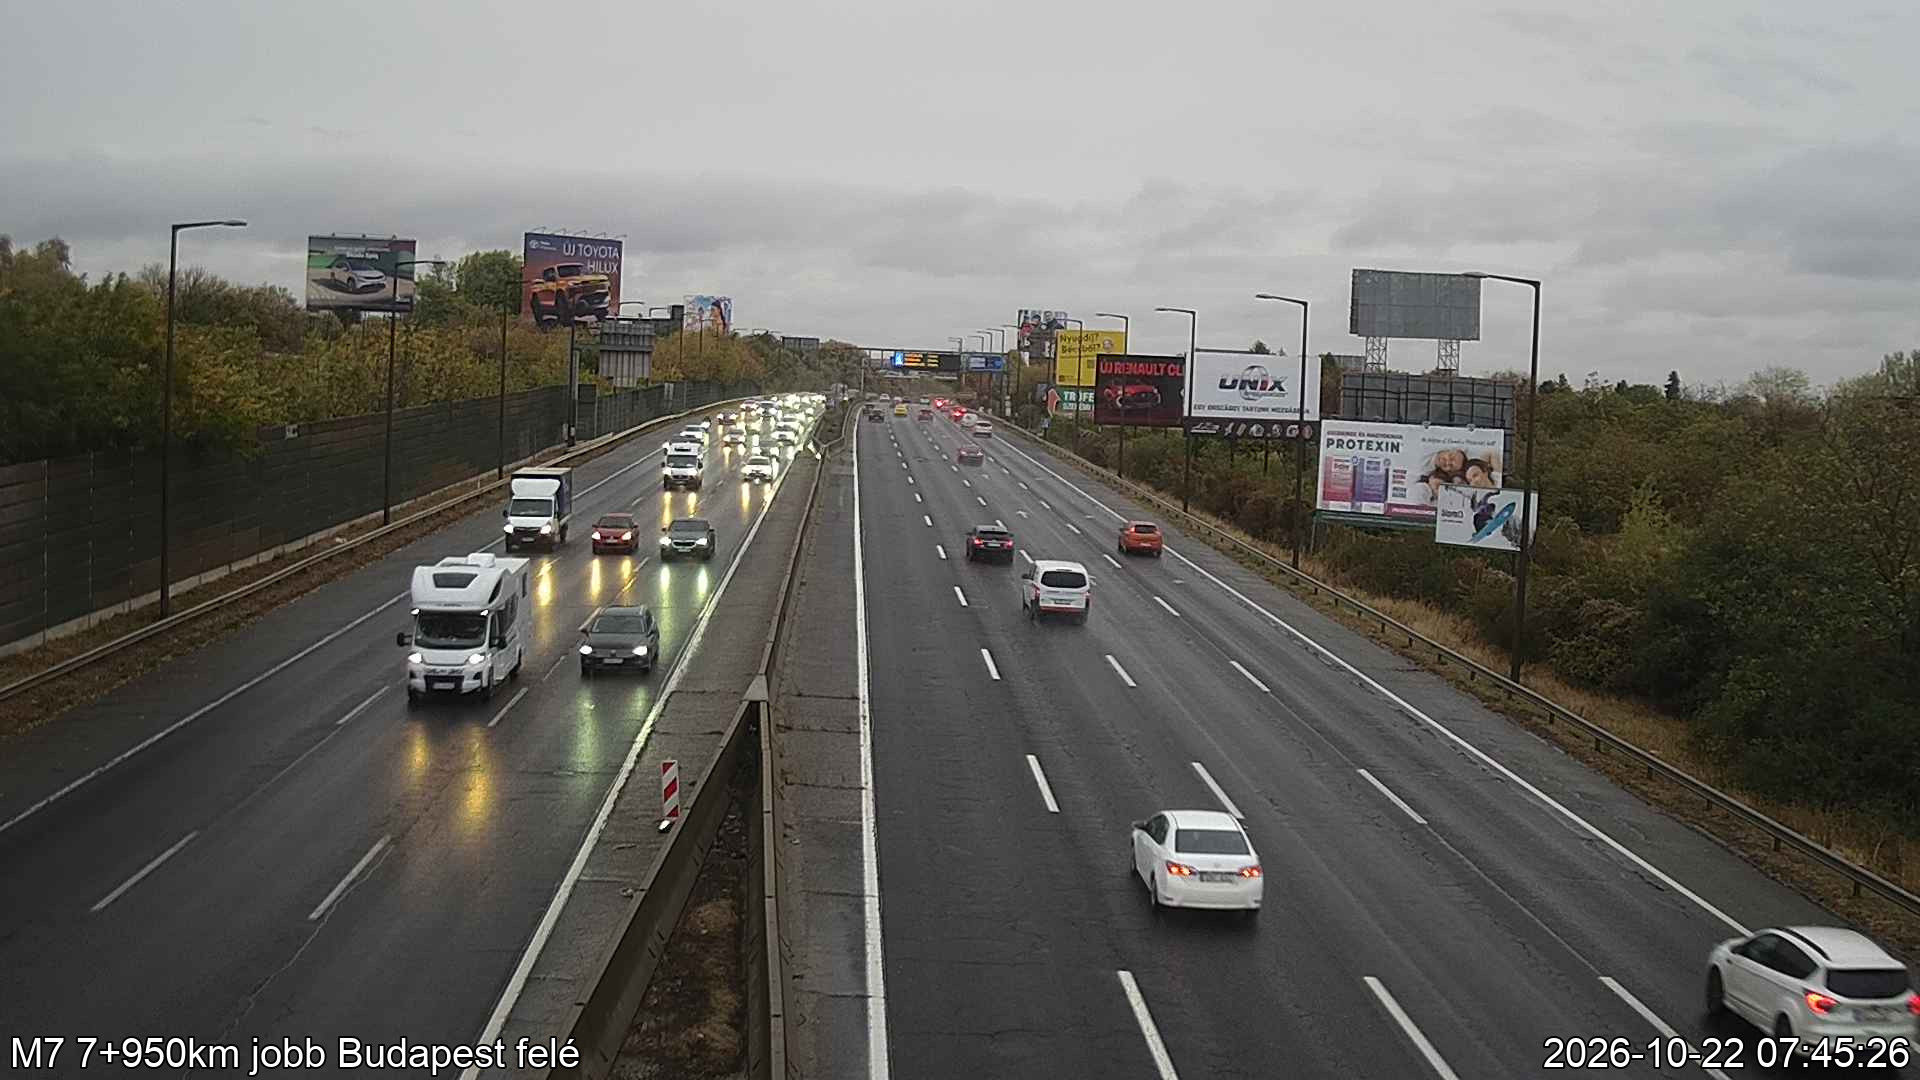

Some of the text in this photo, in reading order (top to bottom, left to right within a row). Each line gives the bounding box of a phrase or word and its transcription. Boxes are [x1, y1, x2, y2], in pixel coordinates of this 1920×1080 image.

[562, 240, 619, 259] ÚJ TOYOTA
[587, 259, 618, 273] HILUX
[1114, 361, 1167, 376] RENAULT
[1219, 376, 1288, 392] UNIX
[1326, 438, 1400, 453] PROTEXIN
